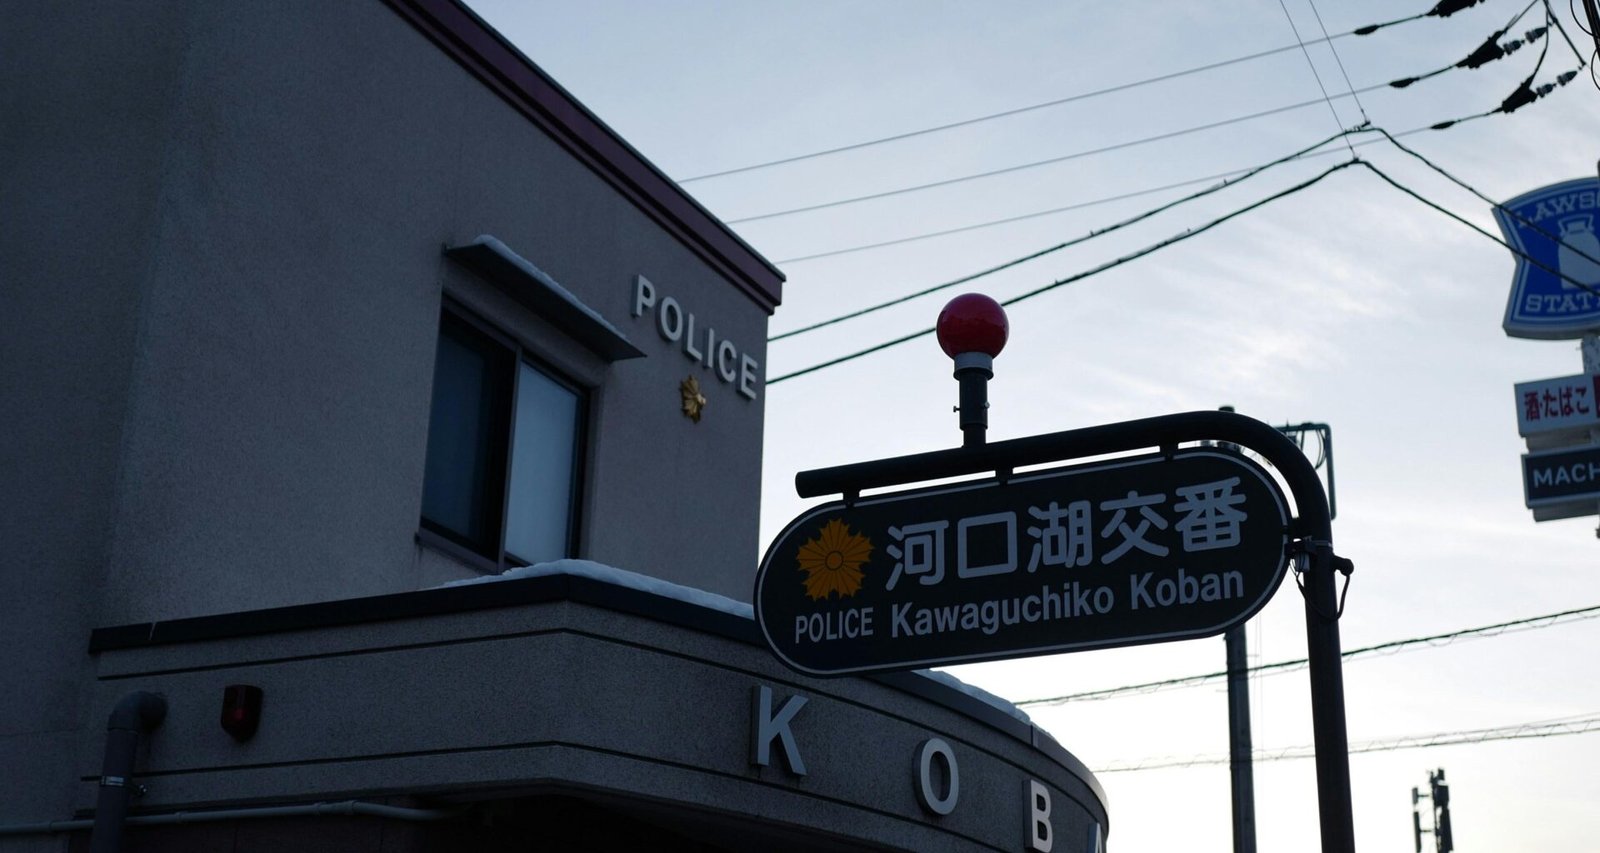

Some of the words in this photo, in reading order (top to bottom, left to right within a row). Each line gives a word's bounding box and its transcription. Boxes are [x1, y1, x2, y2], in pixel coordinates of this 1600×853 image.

[1516, 191, 1600, 228] LAWS
[1525, 290, 1600, 314] STAT
[630, 273, 759, 401] POLICE
[885, 475, 1249, 592] 河口湖交番
[795, 606, 875, 645] POLICE
[891, 581, 1115, 639] Kawaguchiko
[1129, 568, 1245, 611] Koban
